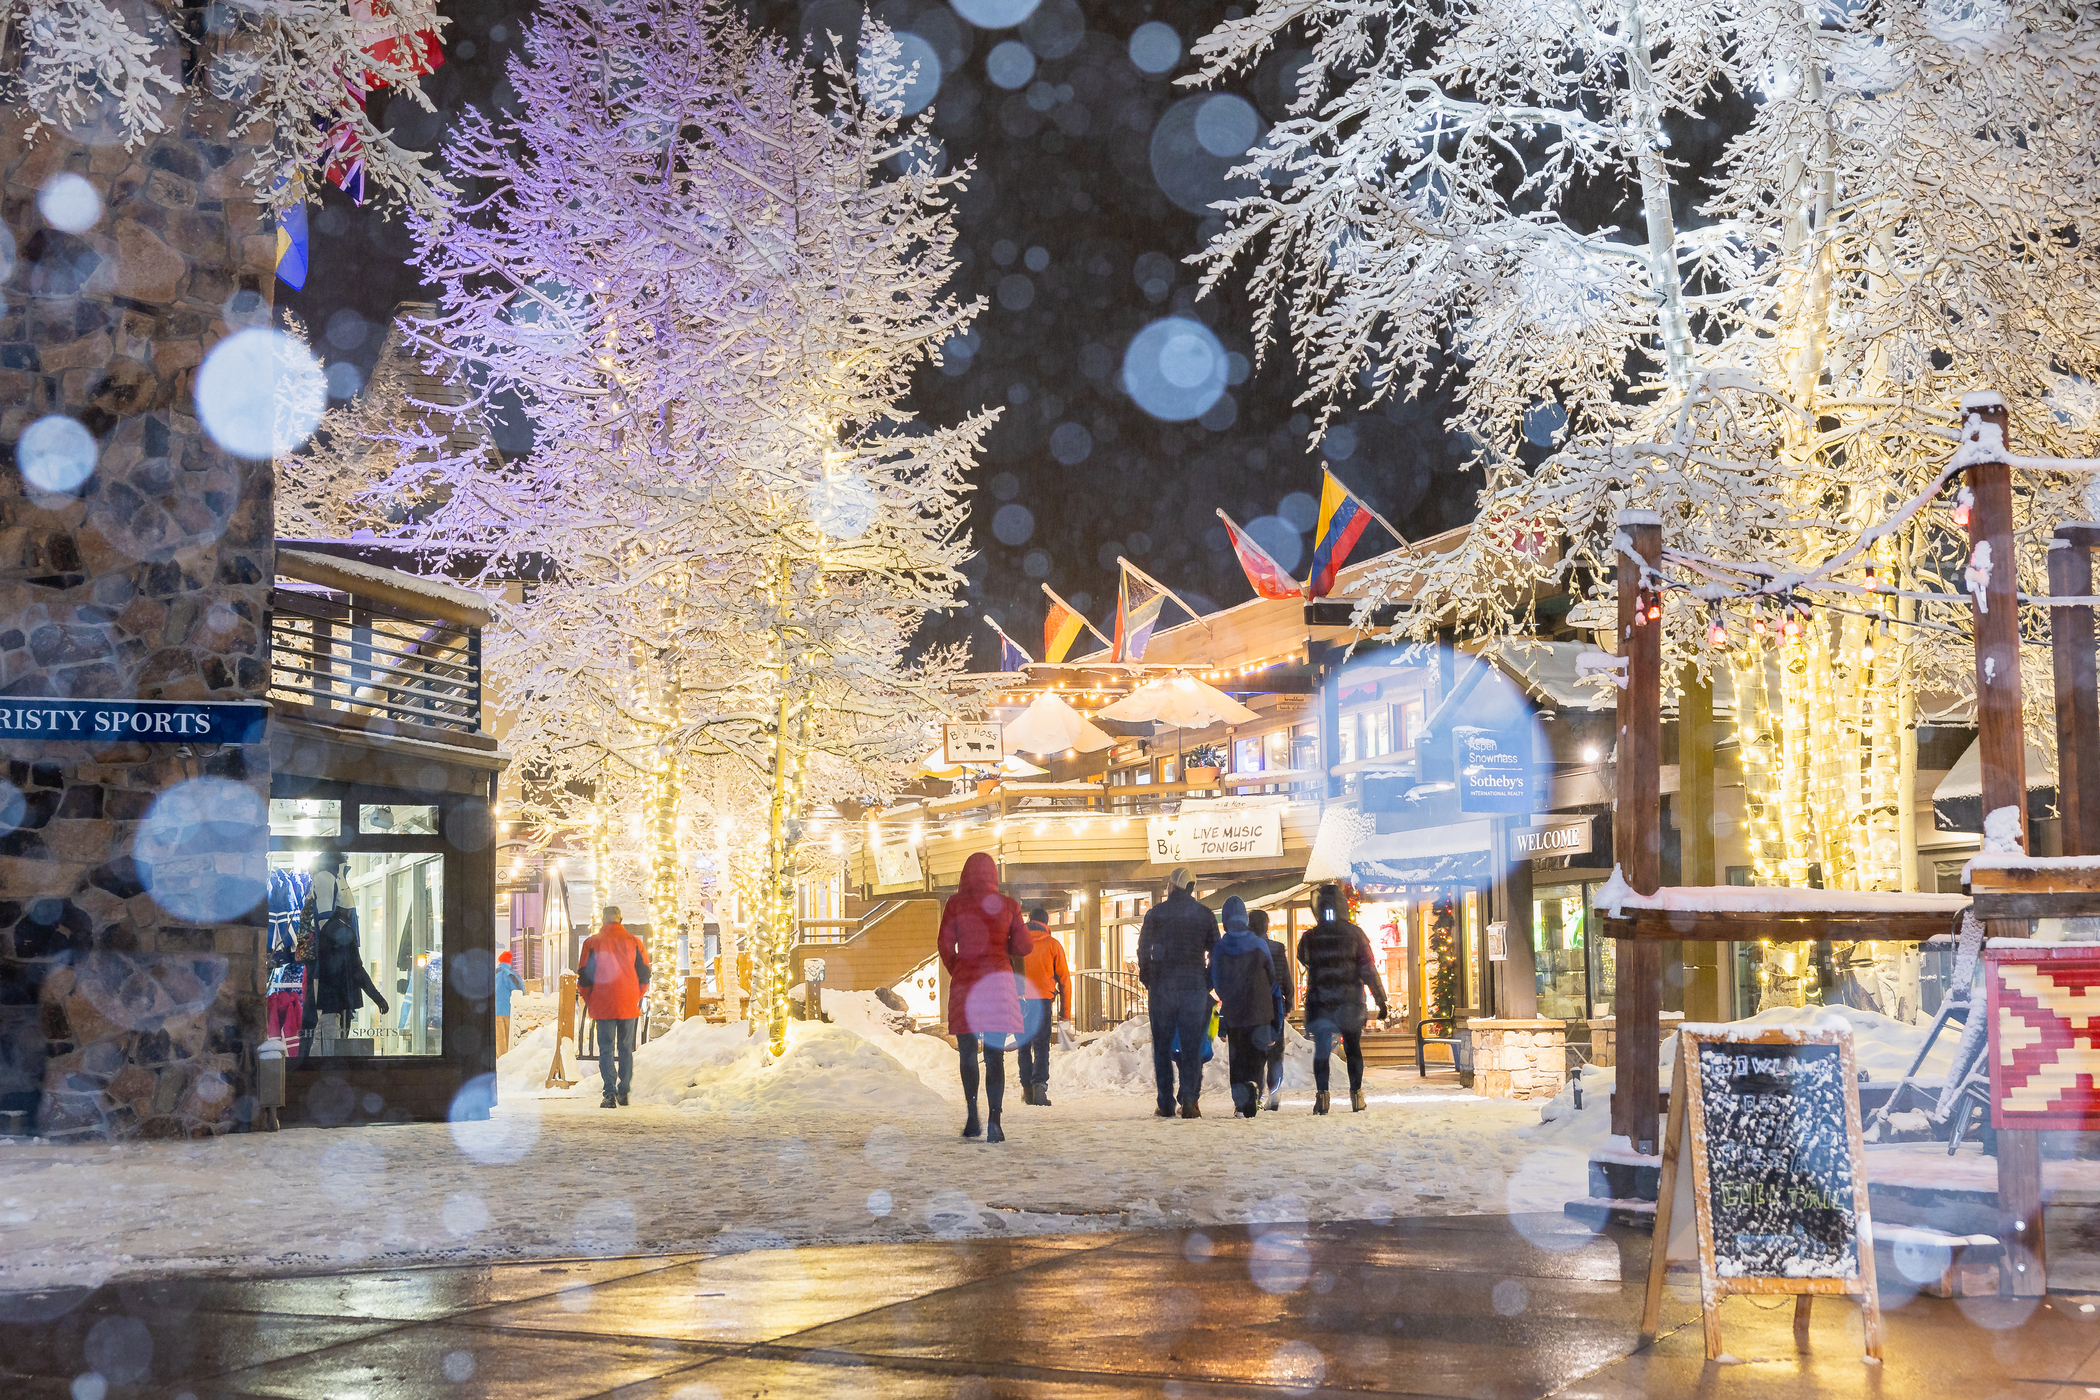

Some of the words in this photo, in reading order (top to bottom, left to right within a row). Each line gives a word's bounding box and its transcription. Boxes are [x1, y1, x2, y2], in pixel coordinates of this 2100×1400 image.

[94, 711, 211, 734] SPORTS
[1468, 741, 1498, 753] Aspen
[1468, 752, 1518, 764] Snowmass
[1469, 774, 1524, 790] Sotheby's
[1193, 827, 1220, 840] LIVE
[1223, 825, 1263, 839] MUSIC
[1516, 828, 1580, 852] WELCOME
[1200, 840, 1256, 854] TONIGHT
[352, 1027, 399, 1038] SPORTS
[1720, 1181, 1845, 1210] COCKTAIL
